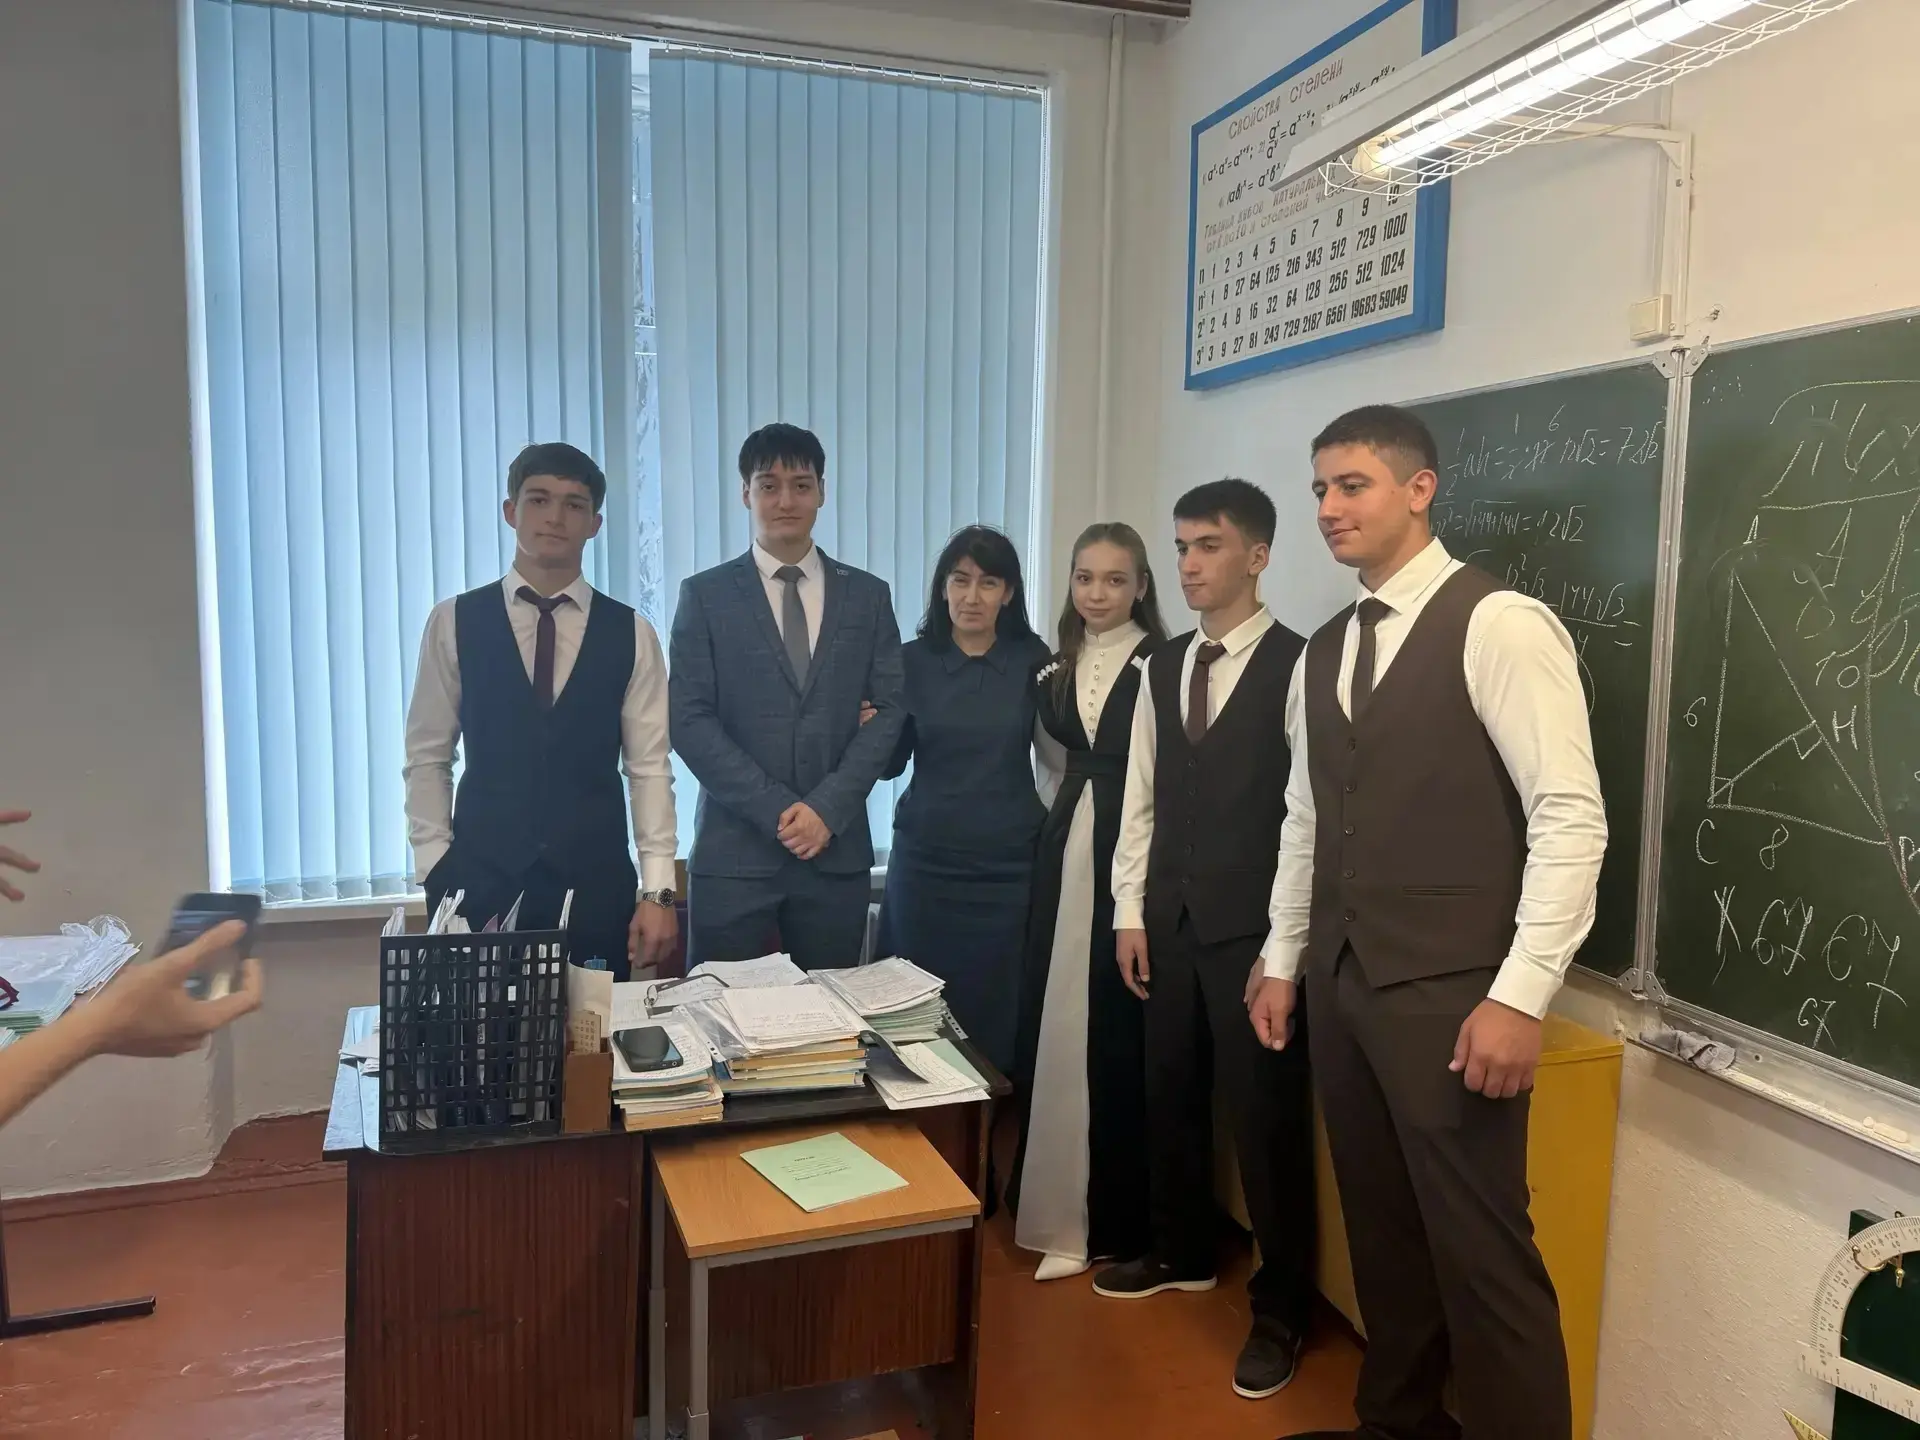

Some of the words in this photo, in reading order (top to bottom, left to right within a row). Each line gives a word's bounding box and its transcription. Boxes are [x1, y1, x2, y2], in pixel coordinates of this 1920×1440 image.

[1211, 289, 1215, 306] 1
[1223, 283, 1229, 300] 8
[1235, 277, 1245, 297] 27
[1249, 270, 1261, 291] 64
[1265, 263, 1280, 285] 125
[1286, 256, 1301, 277] 216
[1305, 246, 1323, 270] 343
[1330, 236, 1347, 261] 512
[1356, 224, 1377, 251] 729
[1383, 211, 1408, 242] 1000
[1212, 263, 1216, 279] 1
[1224, 257, 1230, 274] 2
[1237, 251, 1243, 268] 3
[1252, 244, 1259, 261] 4
[1269, 237, 1276, 254] 5
[1290, 228, 1297, 246] 6
[1311, 218, 1319, 238] 7
[1336, 208, 1344, 227] 8
[1361, 197, 1370, 217] 9
[1387, 184, 1400, 207] 10
[1208, 345, 1214, 362] 3
[1221, 341, 1227, 358] 9
[1233, 335, 1244, 354] 27
[1249, 331, 1258, 349] 81
[1263, 324, 1280, 345] 243
[1283, 318, 1301, 340] 729
[1302, 311, 1323, 334] 2187
[1325, 303, 1347, 327] 6561
[1351, 293, 1378, 319] 19683
[1378, 284, 1409, 311] 59049
[1210, 317, 1216, 334] 2
[1221, 312, 1228, 329] 4
[1235, 307, 1241, 325] 8
[1249, 301, 1258, 321] 16
[1266, 294, 1278, 315] 32
[1286, 287, 1298, 308] 64
[1305, 279, 1321, 302] 128
[1328, 269, 1349, 294] 256
[1355, 260, 1373, 286] 512
[1380, 248, 1406, 277] 1024
